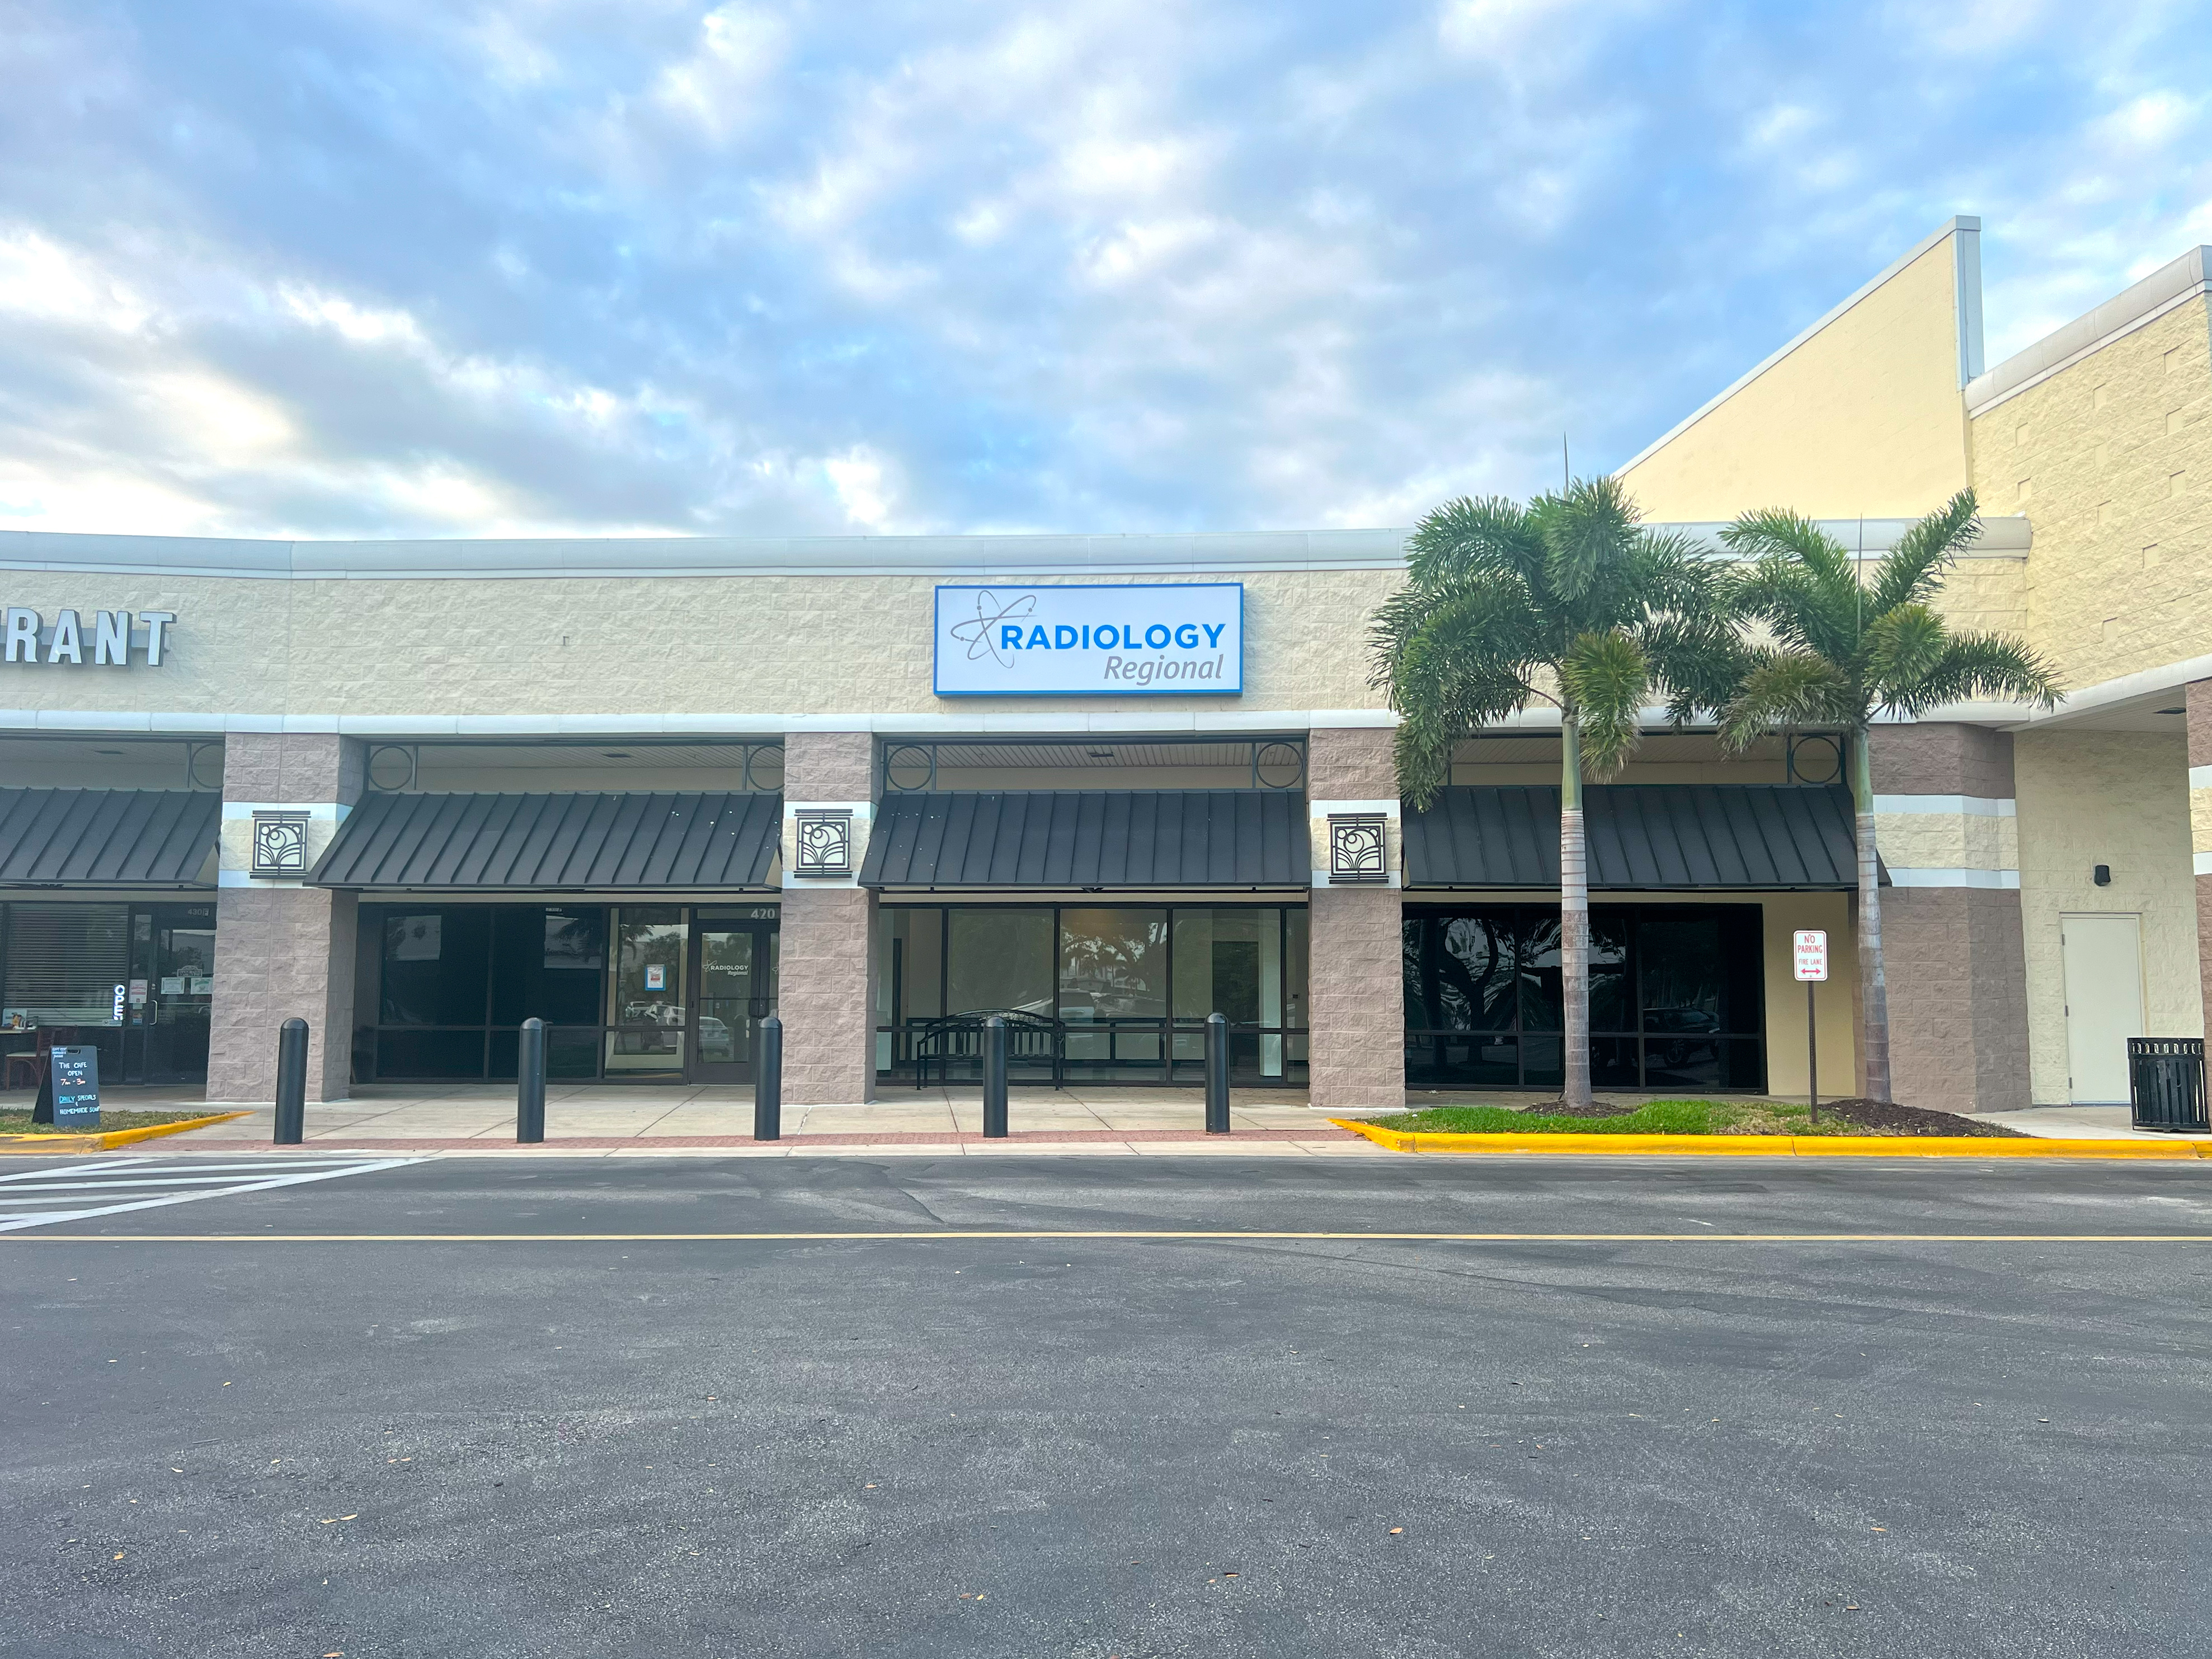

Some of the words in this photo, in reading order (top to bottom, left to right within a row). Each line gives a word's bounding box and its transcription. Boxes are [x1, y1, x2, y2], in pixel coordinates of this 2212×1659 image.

[1001, 623, 1226, 650] RADIOLOGY
[1104, 654, 1224, 686] Regional
[751, 908, 775, 919] 420
[1797, 945, 1823, 953] PARKING
[114, 985, 125, 1020] OPE
